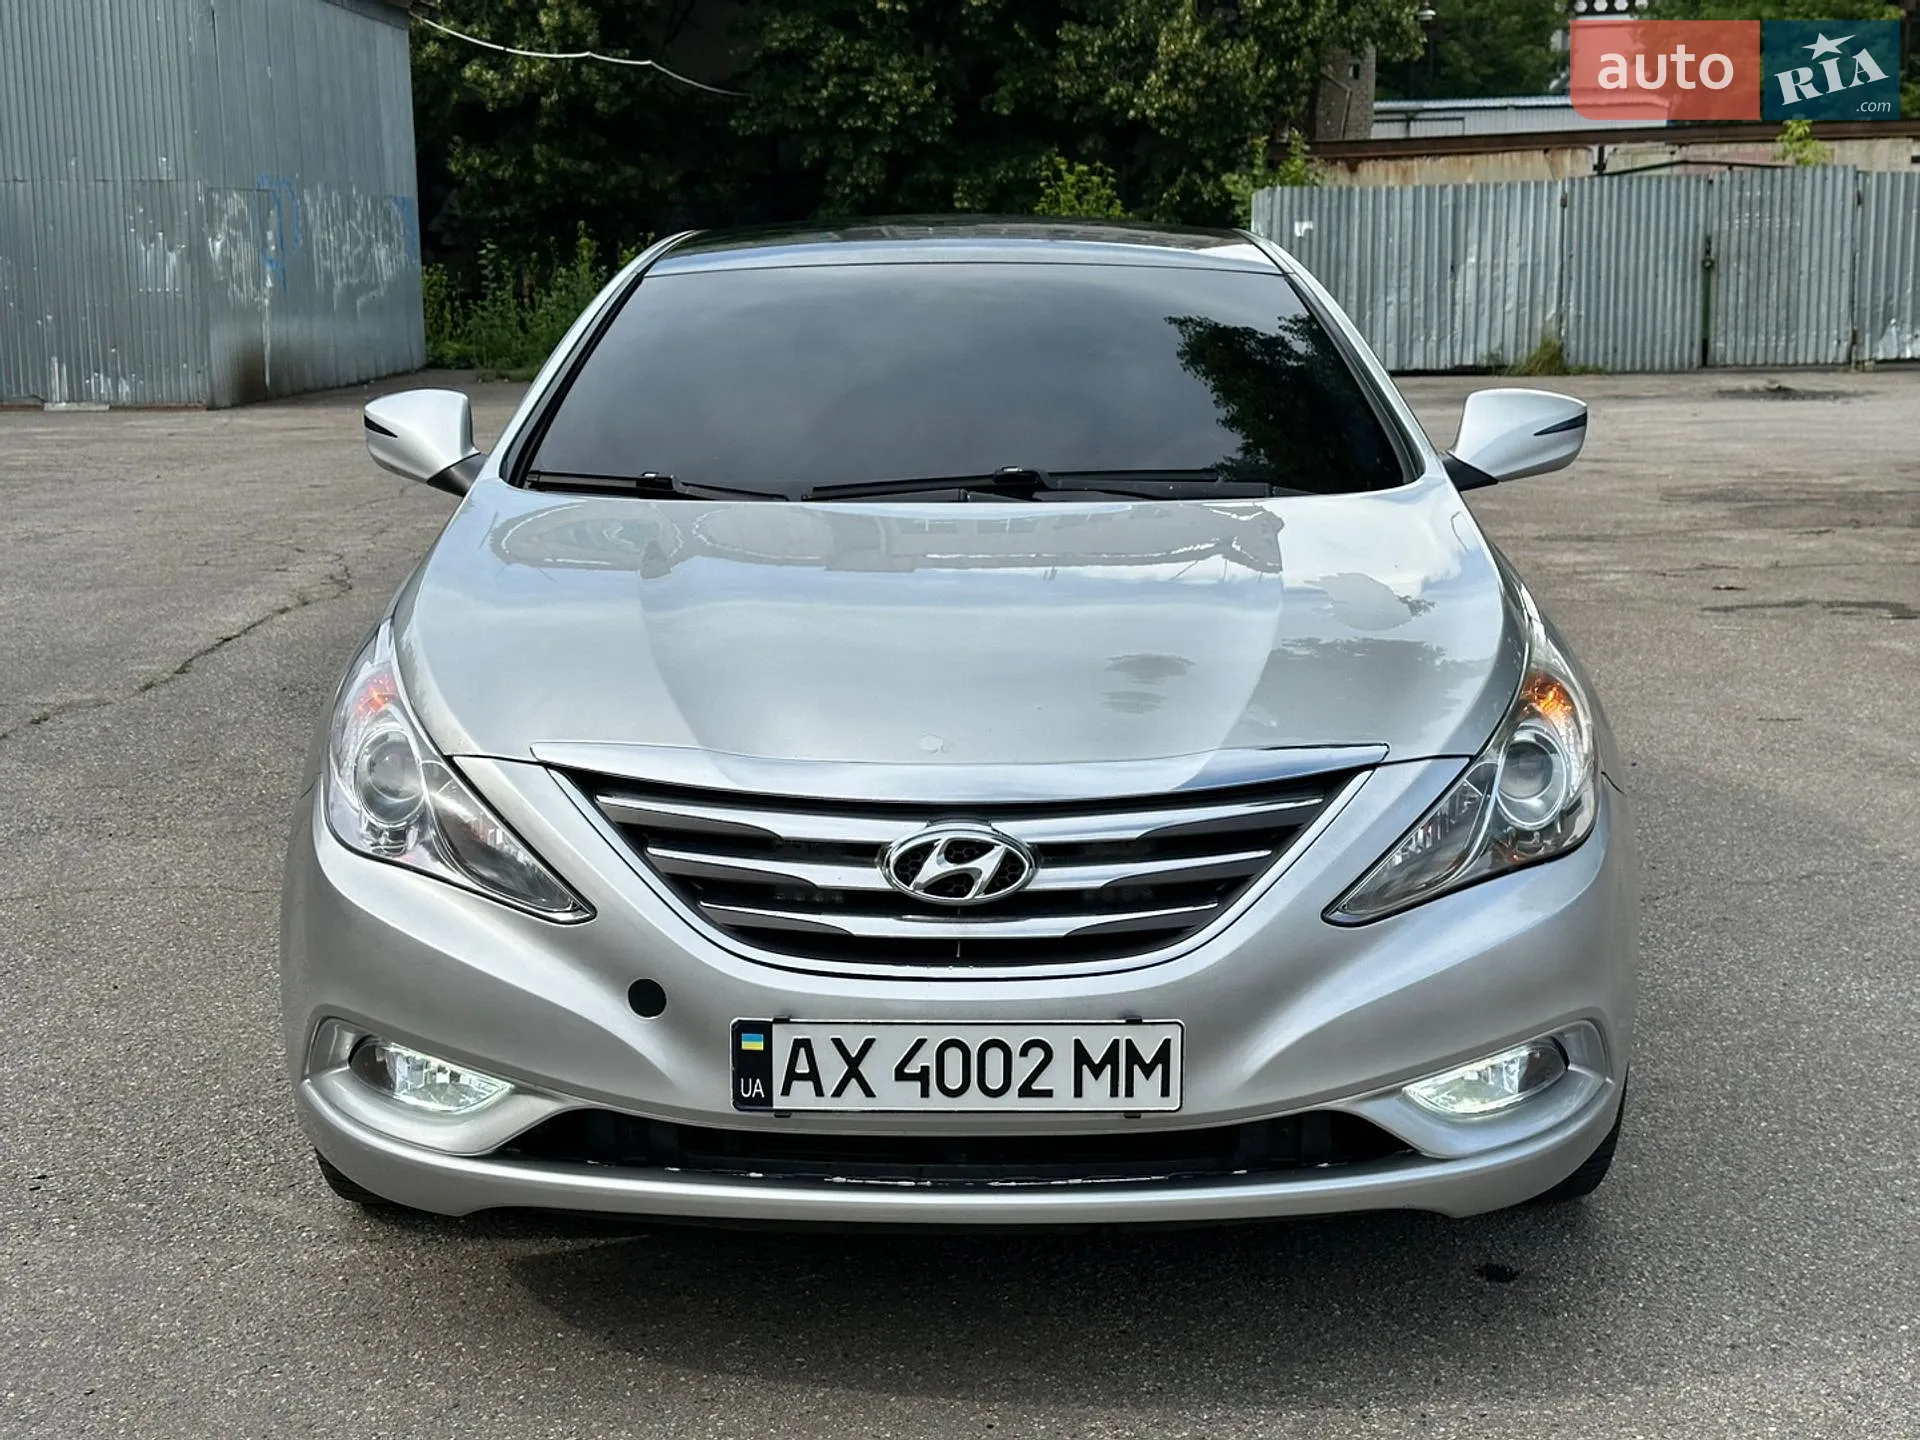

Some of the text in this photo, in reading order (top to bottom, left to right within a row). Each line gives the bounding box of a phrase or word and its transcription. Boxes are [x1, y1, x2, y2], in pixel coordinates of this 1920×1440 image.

[780, 1037, 1172, 1098] AX 4002 MM
[740, 1078, 765, 1098] UA
